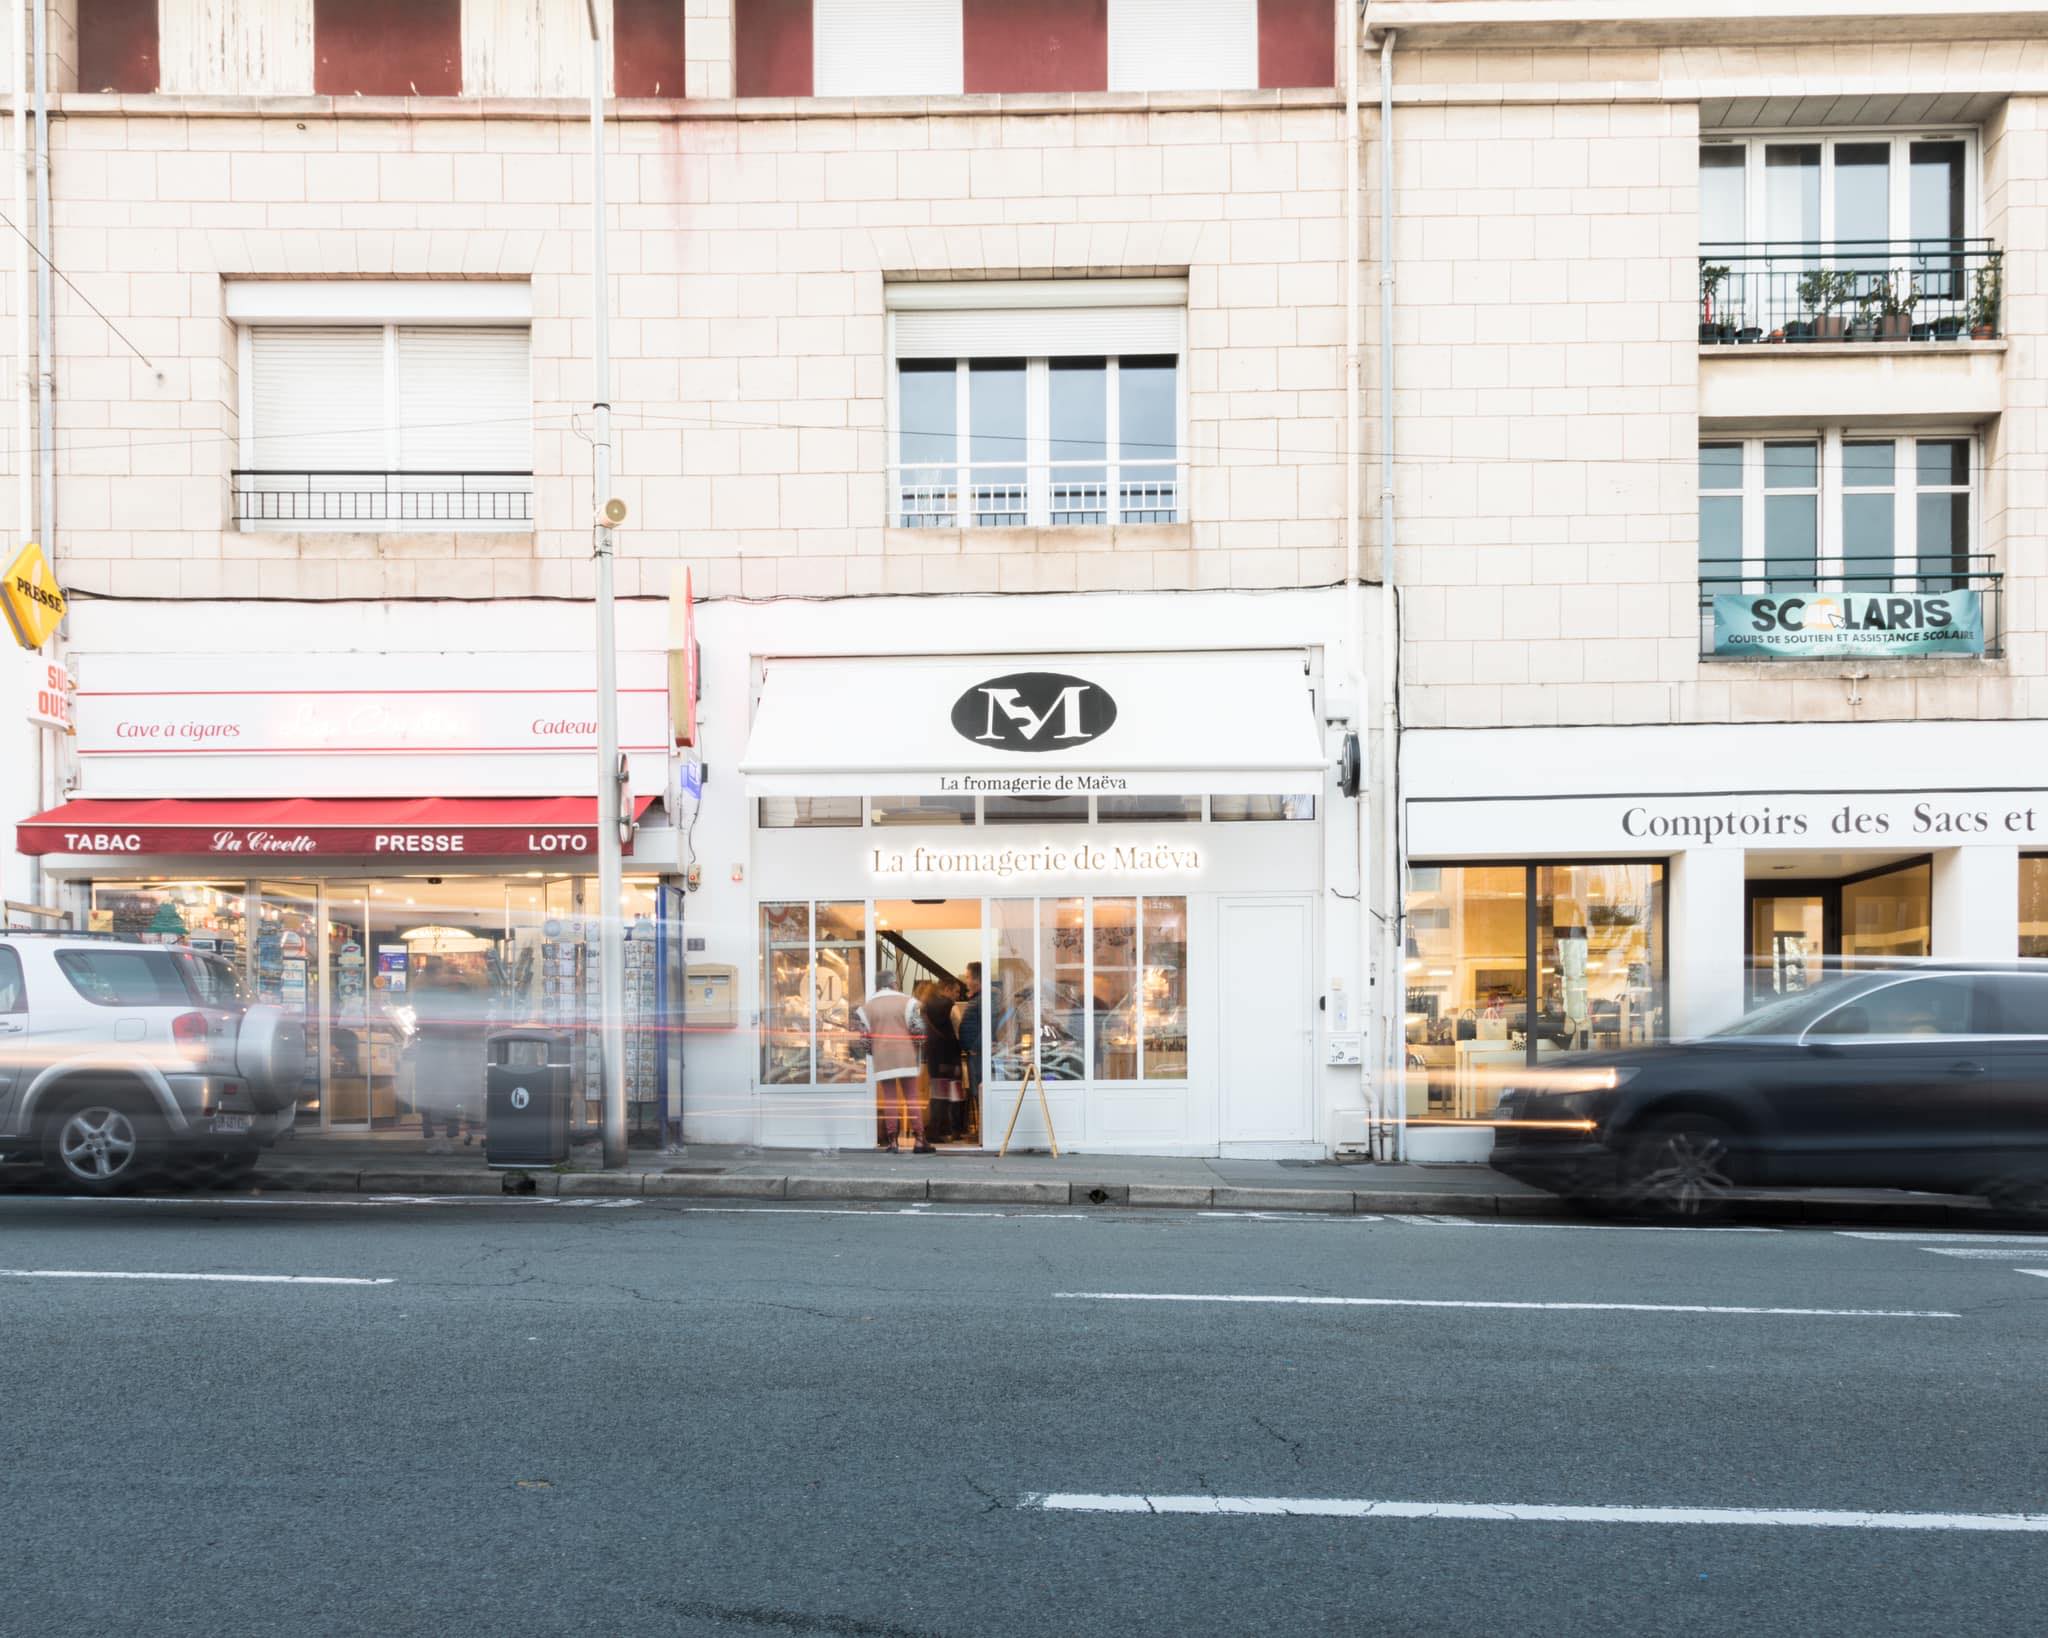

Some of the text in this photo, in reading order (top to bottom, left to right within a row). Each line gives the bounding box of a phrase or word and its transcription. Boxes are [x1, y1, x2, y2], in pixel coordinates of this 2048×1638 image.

[17, 576, 62, 613] PRESSE
[1728, 634, 1764, 644] COURS
[1767, 635, 1780, 644] DE
[1784, 634, 1832, 644] SOUTIEN
[1837, 633, 1848, 642] ET
[1852, 632, 1920, 642] ASSISTANCE
[47, 664, 67, 693] SU
[116, 721, 160, 738] Cave
[180, 721, 240, 742] cigares
[531, 719, 598, 735] Cadeau
[940, 775, 1127, 793] La fromagerie de Maëva
[1621, 803, 2038, 844] Comptoirs des Sacs et
[64, 833, 141, 851] TABAC
[210, 831, 317, 852] La Civette
[375, 834, 464, 852] PRESSE
[528, 834, 588, 851] LOTO
[872, 845, 1200, 876] La fromagerie de Maëva
